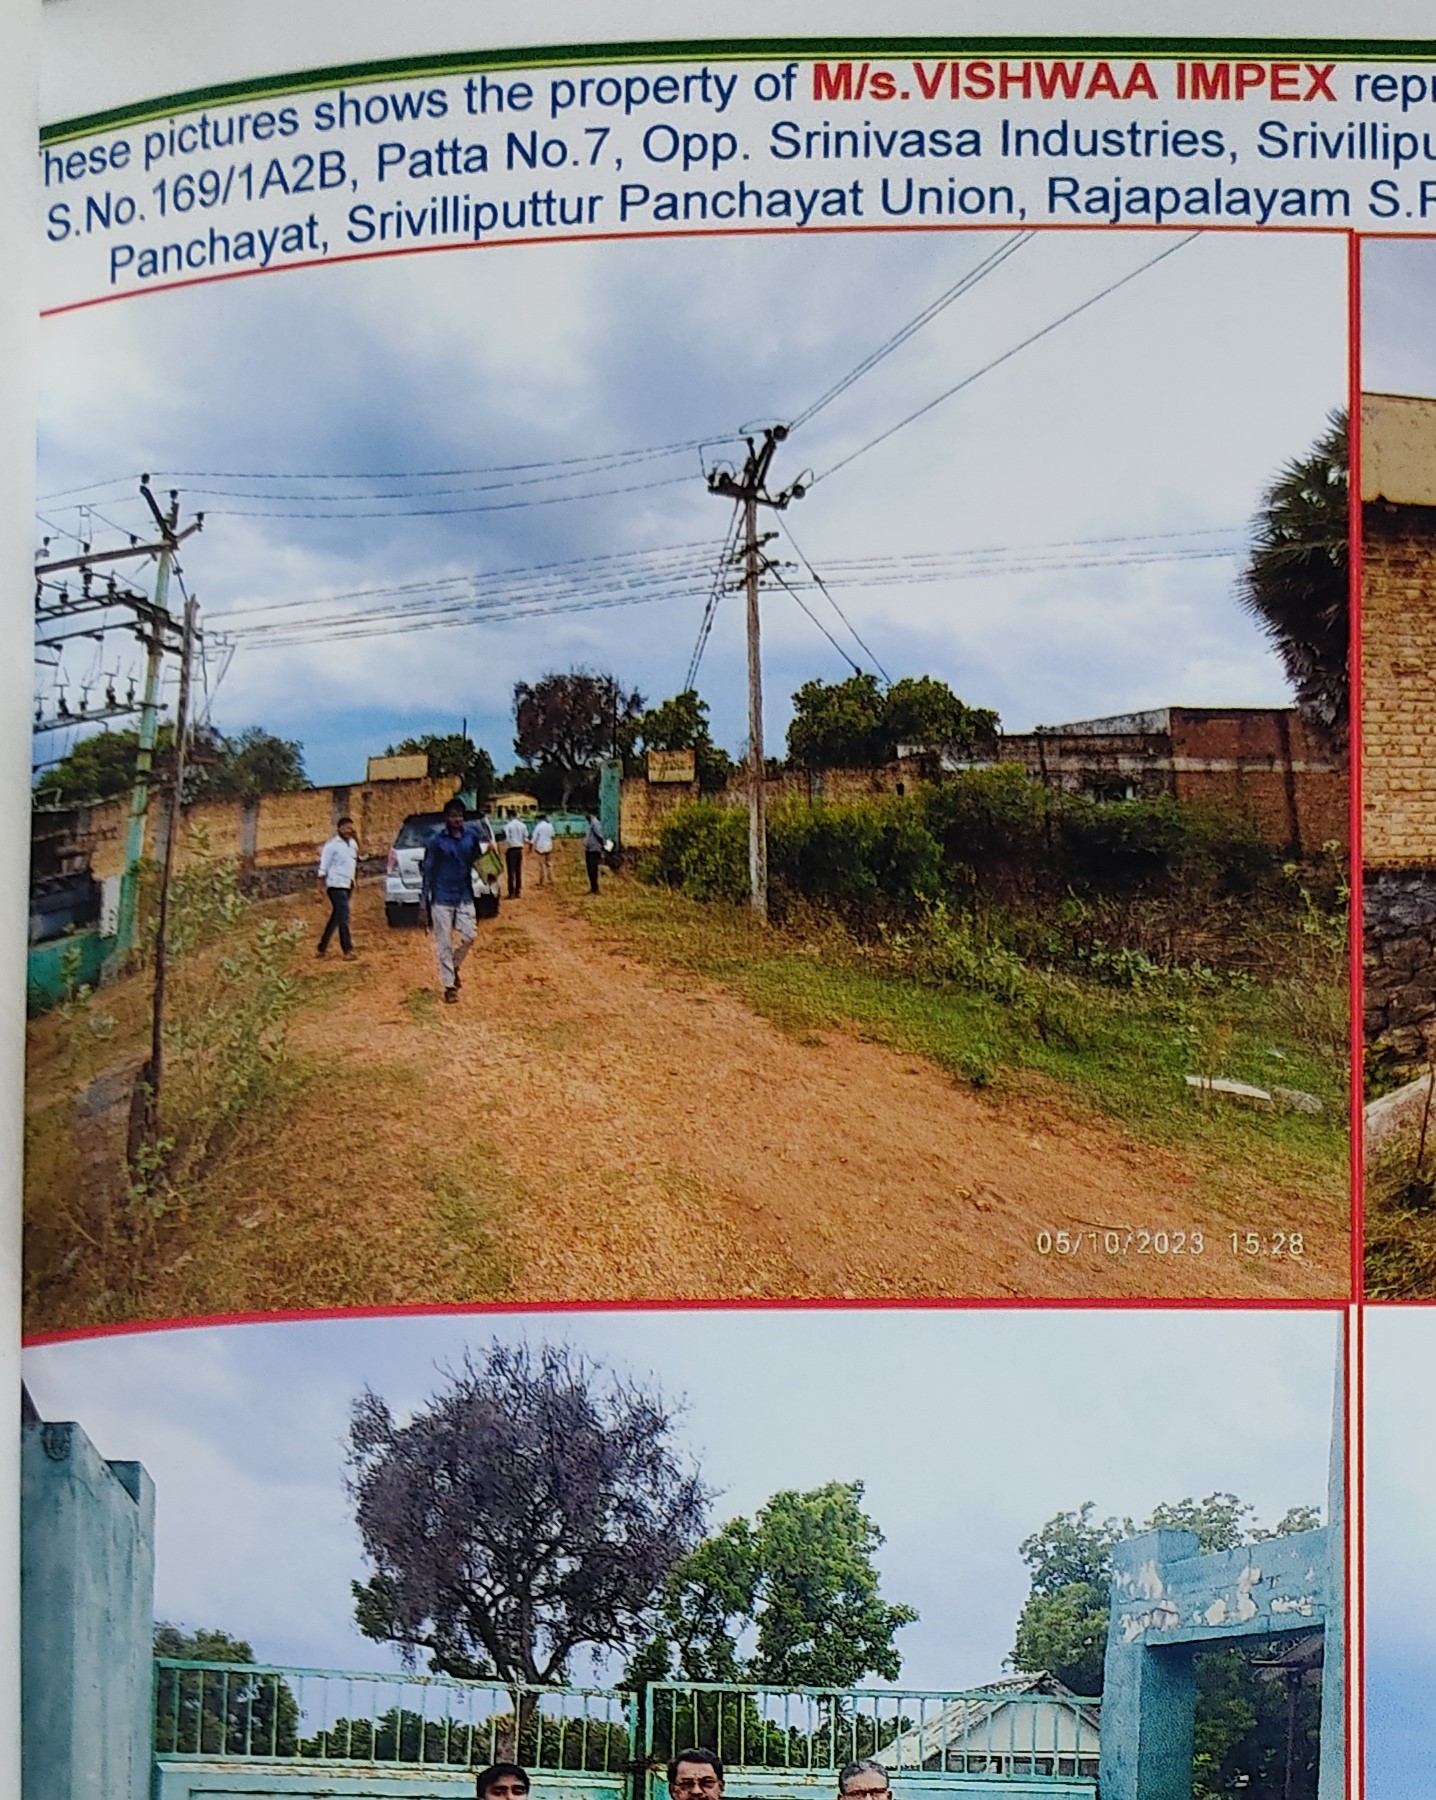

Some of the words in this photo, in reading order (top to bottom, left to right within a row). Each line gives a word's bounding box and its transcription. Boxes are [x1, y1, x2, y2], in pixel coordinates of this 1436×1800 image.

[40, 140, 132, 187] hese
[144, 107, 301, 170] pictures
[314, 88, 450, 133] shows
[463, 75, 535, 116] the
[550, 66, 739, 120] property
[754, 63, 797, 103] of
[811, 61, 1158, 101] M/s.VISHWAA
[1177, 63, 1335, 102] IMPEX
[46, 150, 359, 242] S.No.169/1A2B,
[377, 137, 489, 183] Patta
[506, 127, 623, 170] No.7,
[643, 124, 750, 172] Opp.
[770, 120, 982, 161] Srinivasa
[1001, 119, 1238, 163] Industries,
[109, 213, 329, 284] Panchayat,
[346, 194, 605, 243] Srivilliputtur
[620, 180, 865, 225] Panchayat
[881, 176, 1027, 217] Union,
[1048, 176, 1351, 224] Rajapalayam
